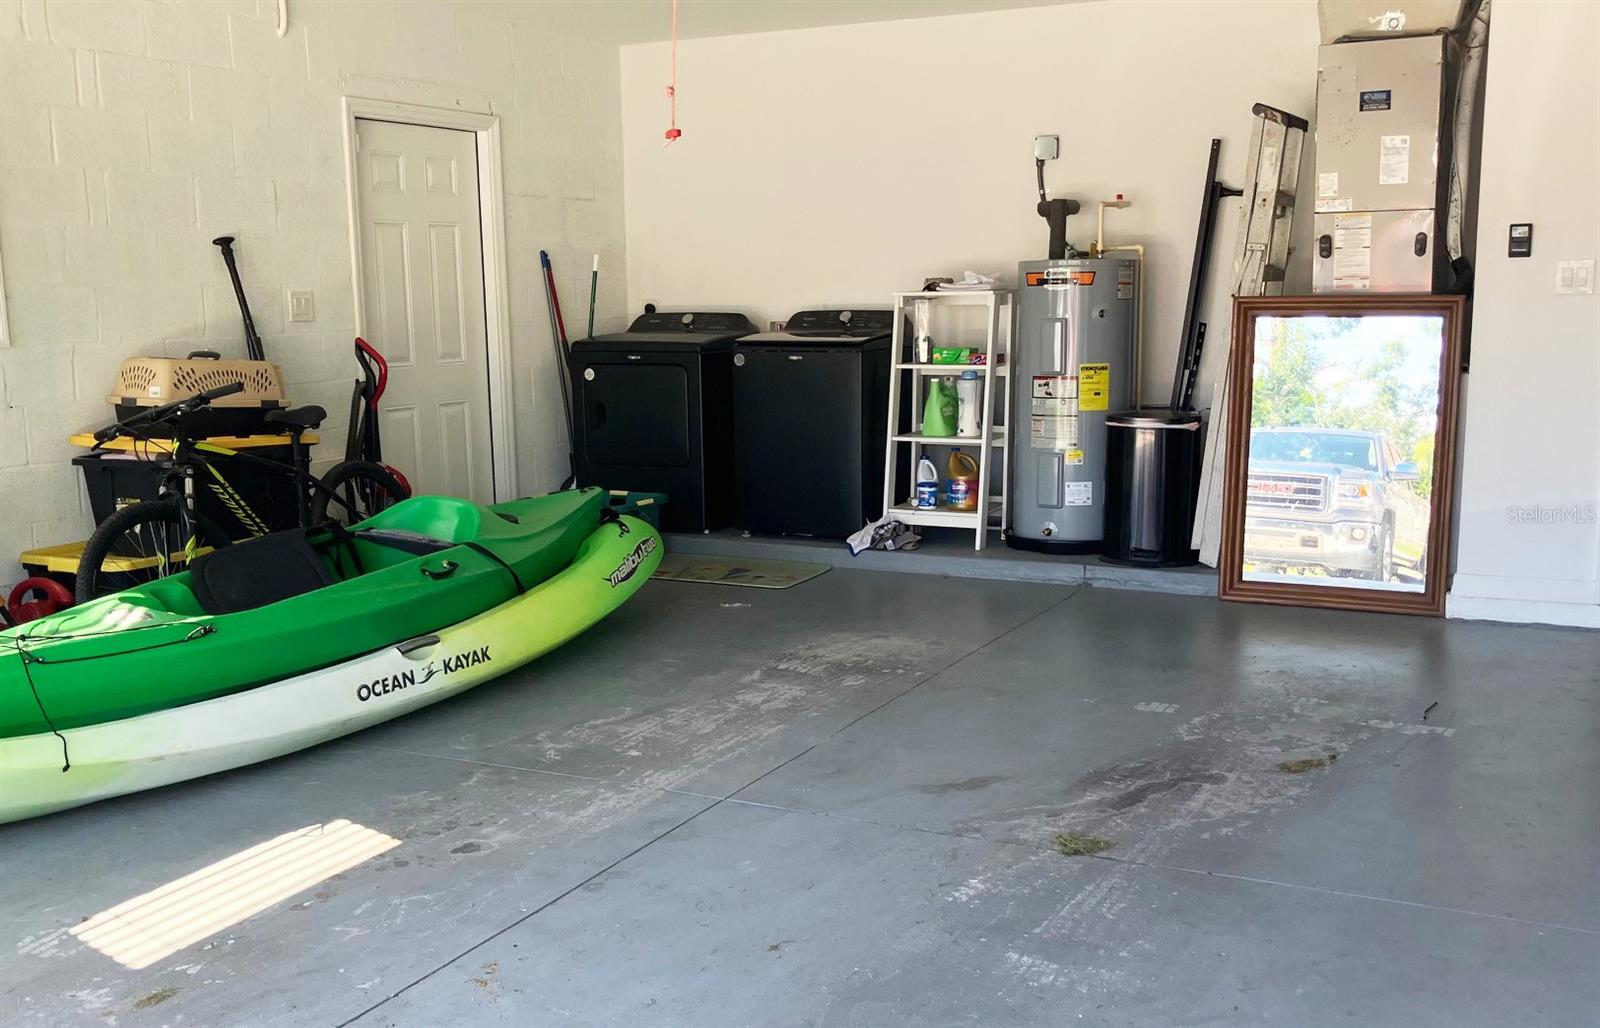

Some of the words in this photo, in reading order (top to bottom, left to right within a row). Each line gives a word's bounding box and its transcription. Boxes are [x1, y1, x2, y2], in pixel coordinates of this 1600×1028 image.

[611, 549, 644, 586] malibu
[640, 537, 657, 556] two
[356, 669, 416, 702] OCEAN
[442, 646, 492, 675] KAYAK
